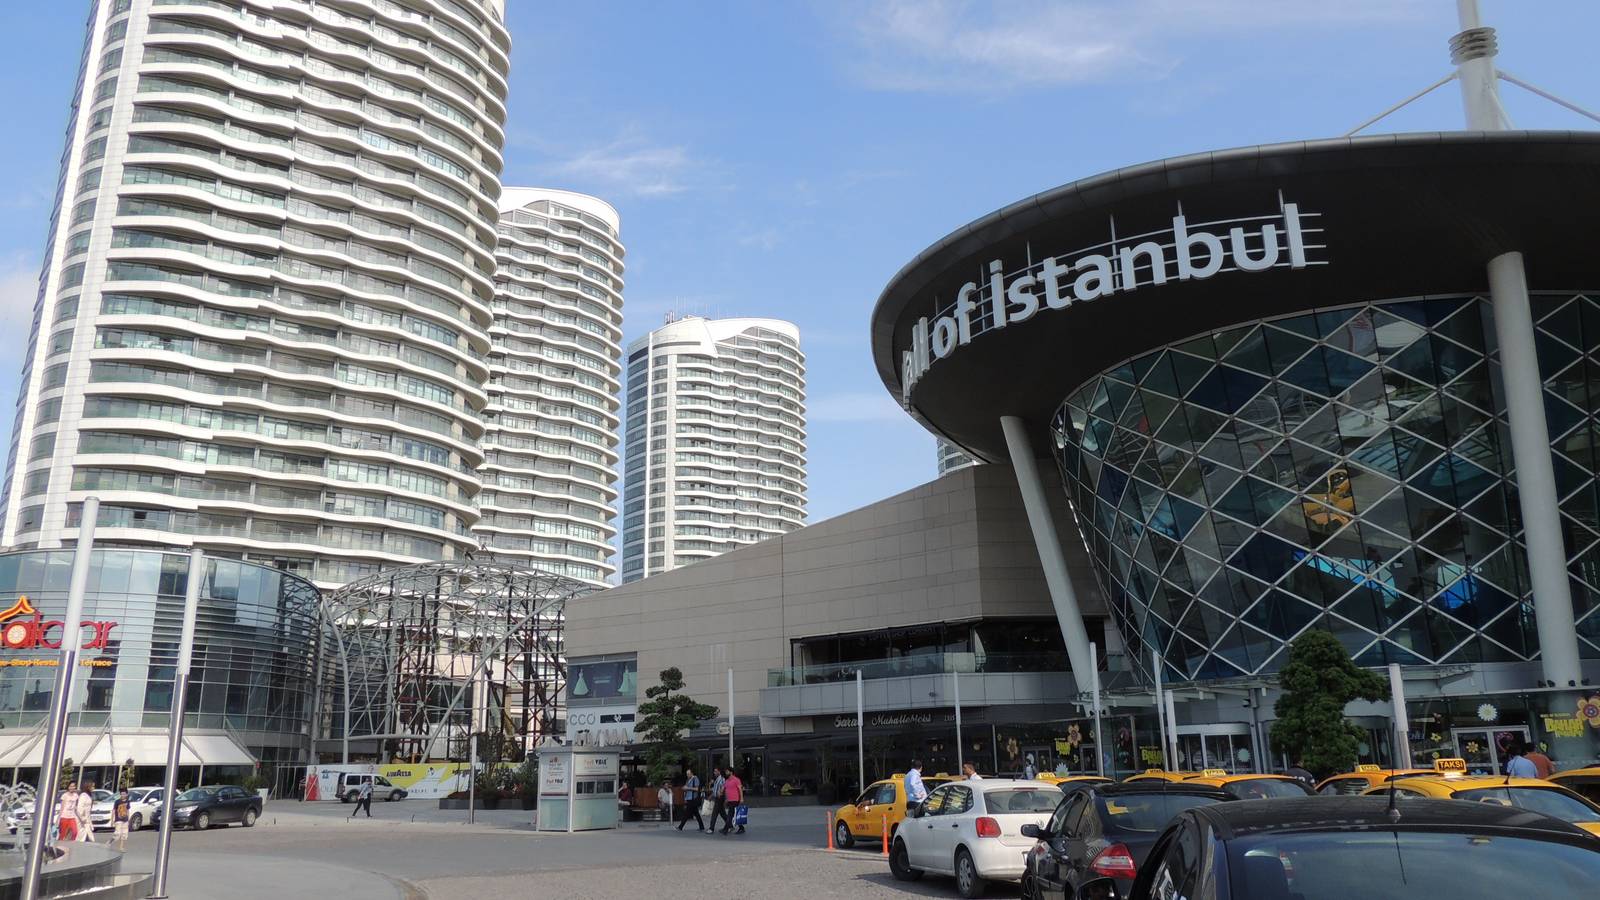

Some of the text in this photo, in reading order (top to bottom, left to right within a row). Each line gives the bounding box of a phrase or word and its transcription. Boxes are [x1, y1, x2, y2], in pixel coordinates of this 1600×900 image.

[932, 282, 977, 358] of
[990, 203, 1306, 329] istanbul
[834, 714, 860, 728] Sara
